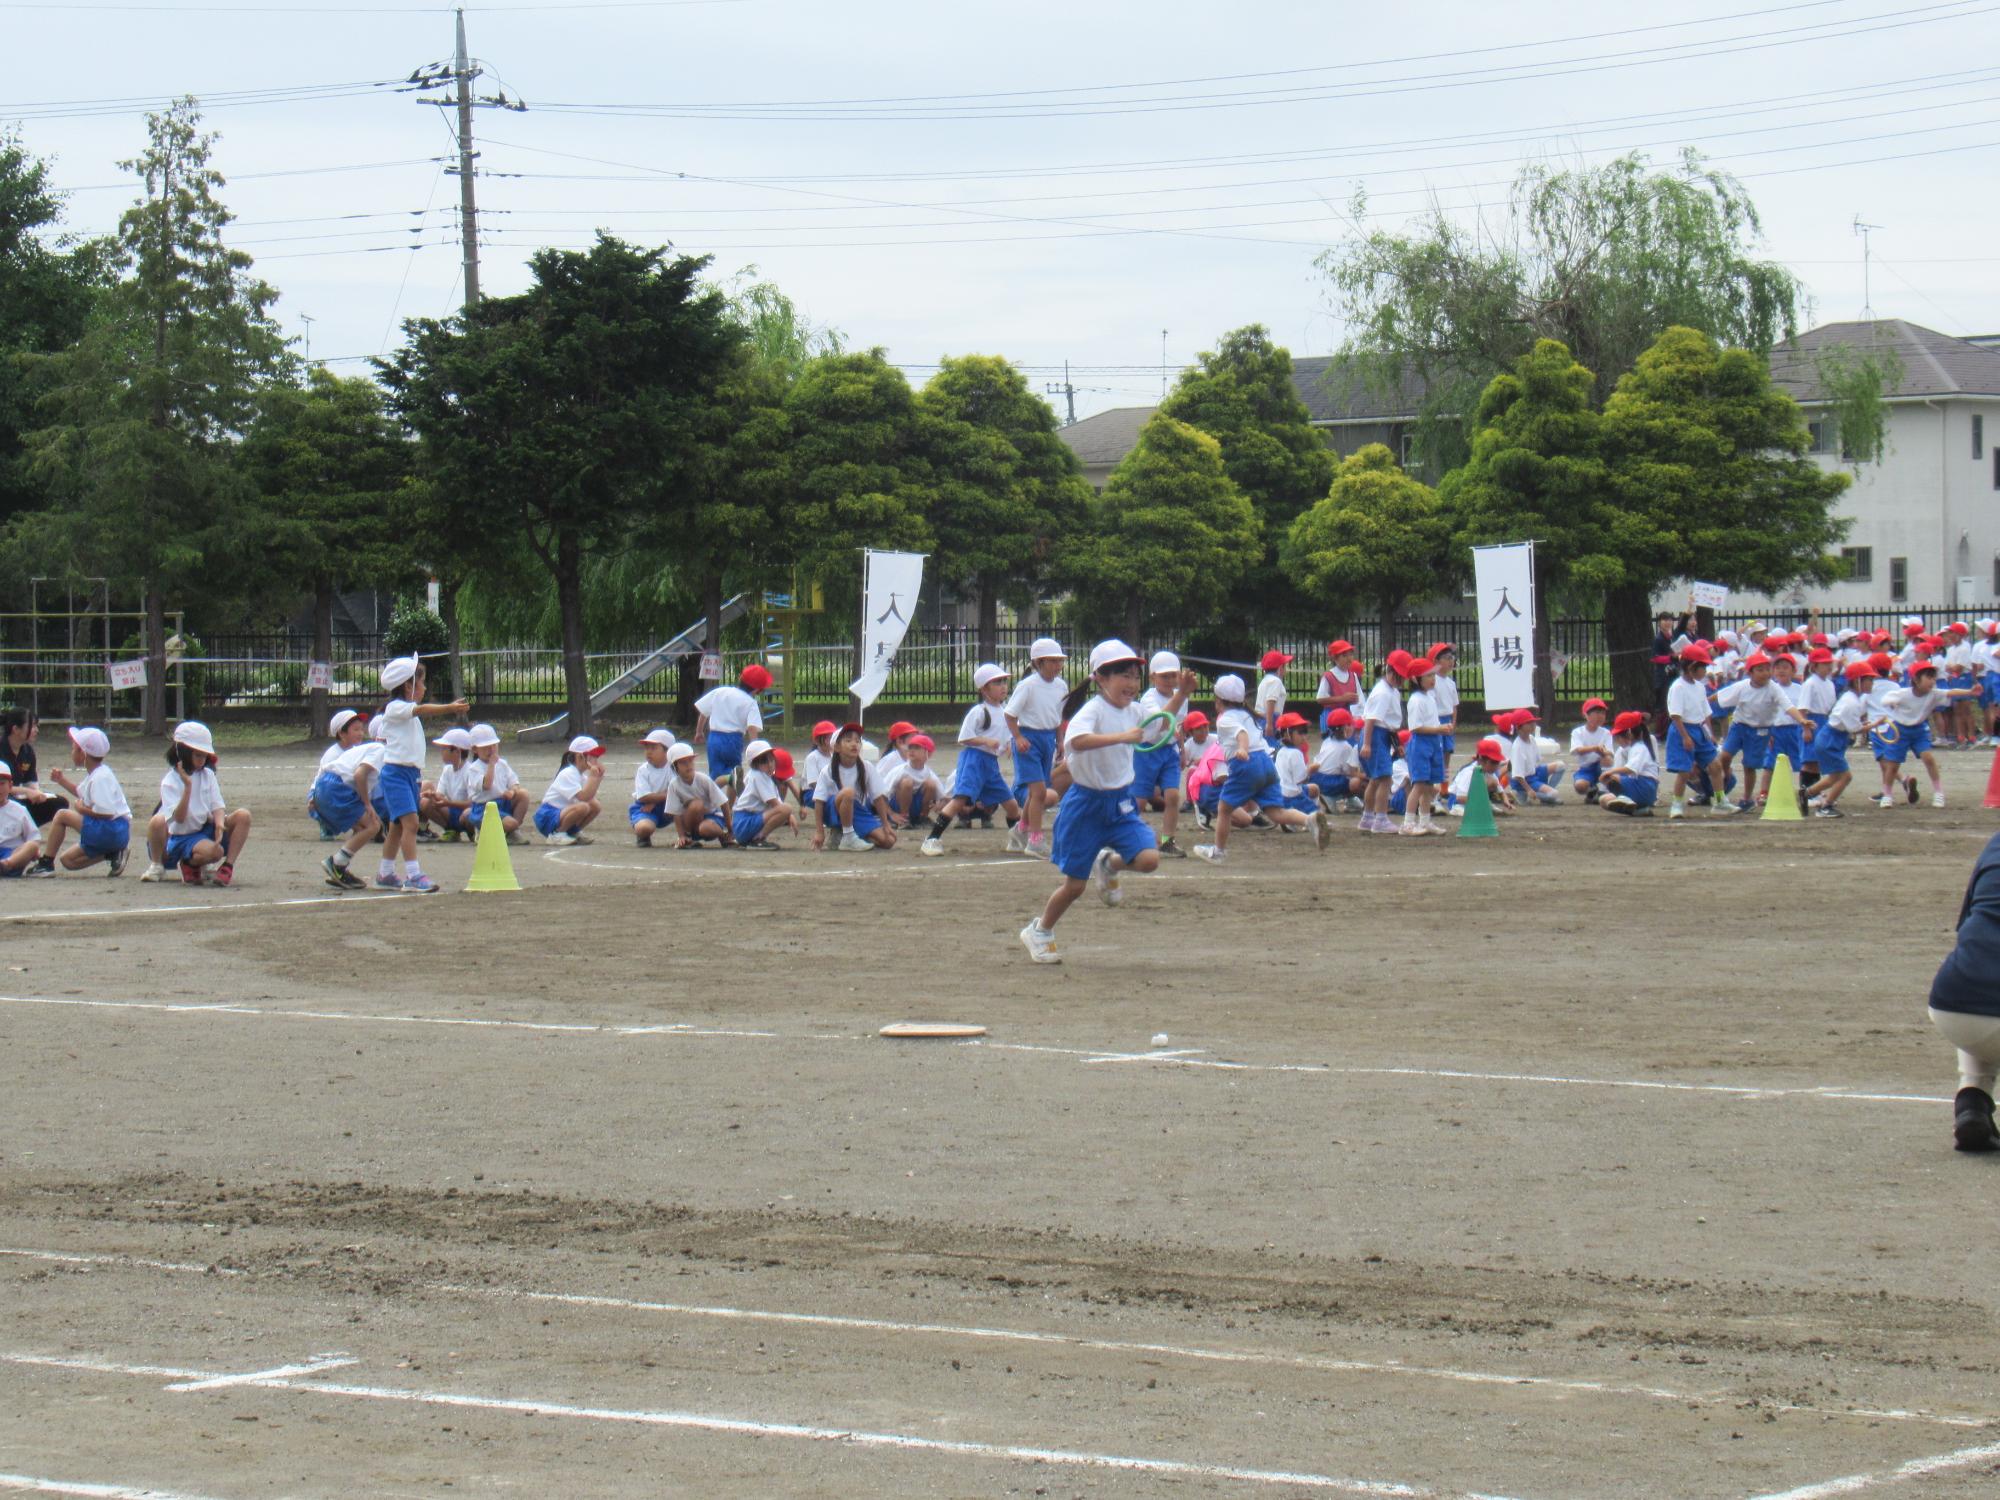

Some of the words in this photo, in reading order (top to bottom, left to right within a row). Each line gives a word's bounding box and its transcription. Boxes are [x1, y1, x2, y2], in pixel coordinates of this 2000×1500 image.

[1489, 586, 1524, 671] 入場
[114, 664, 141, 676] 立ち入り
